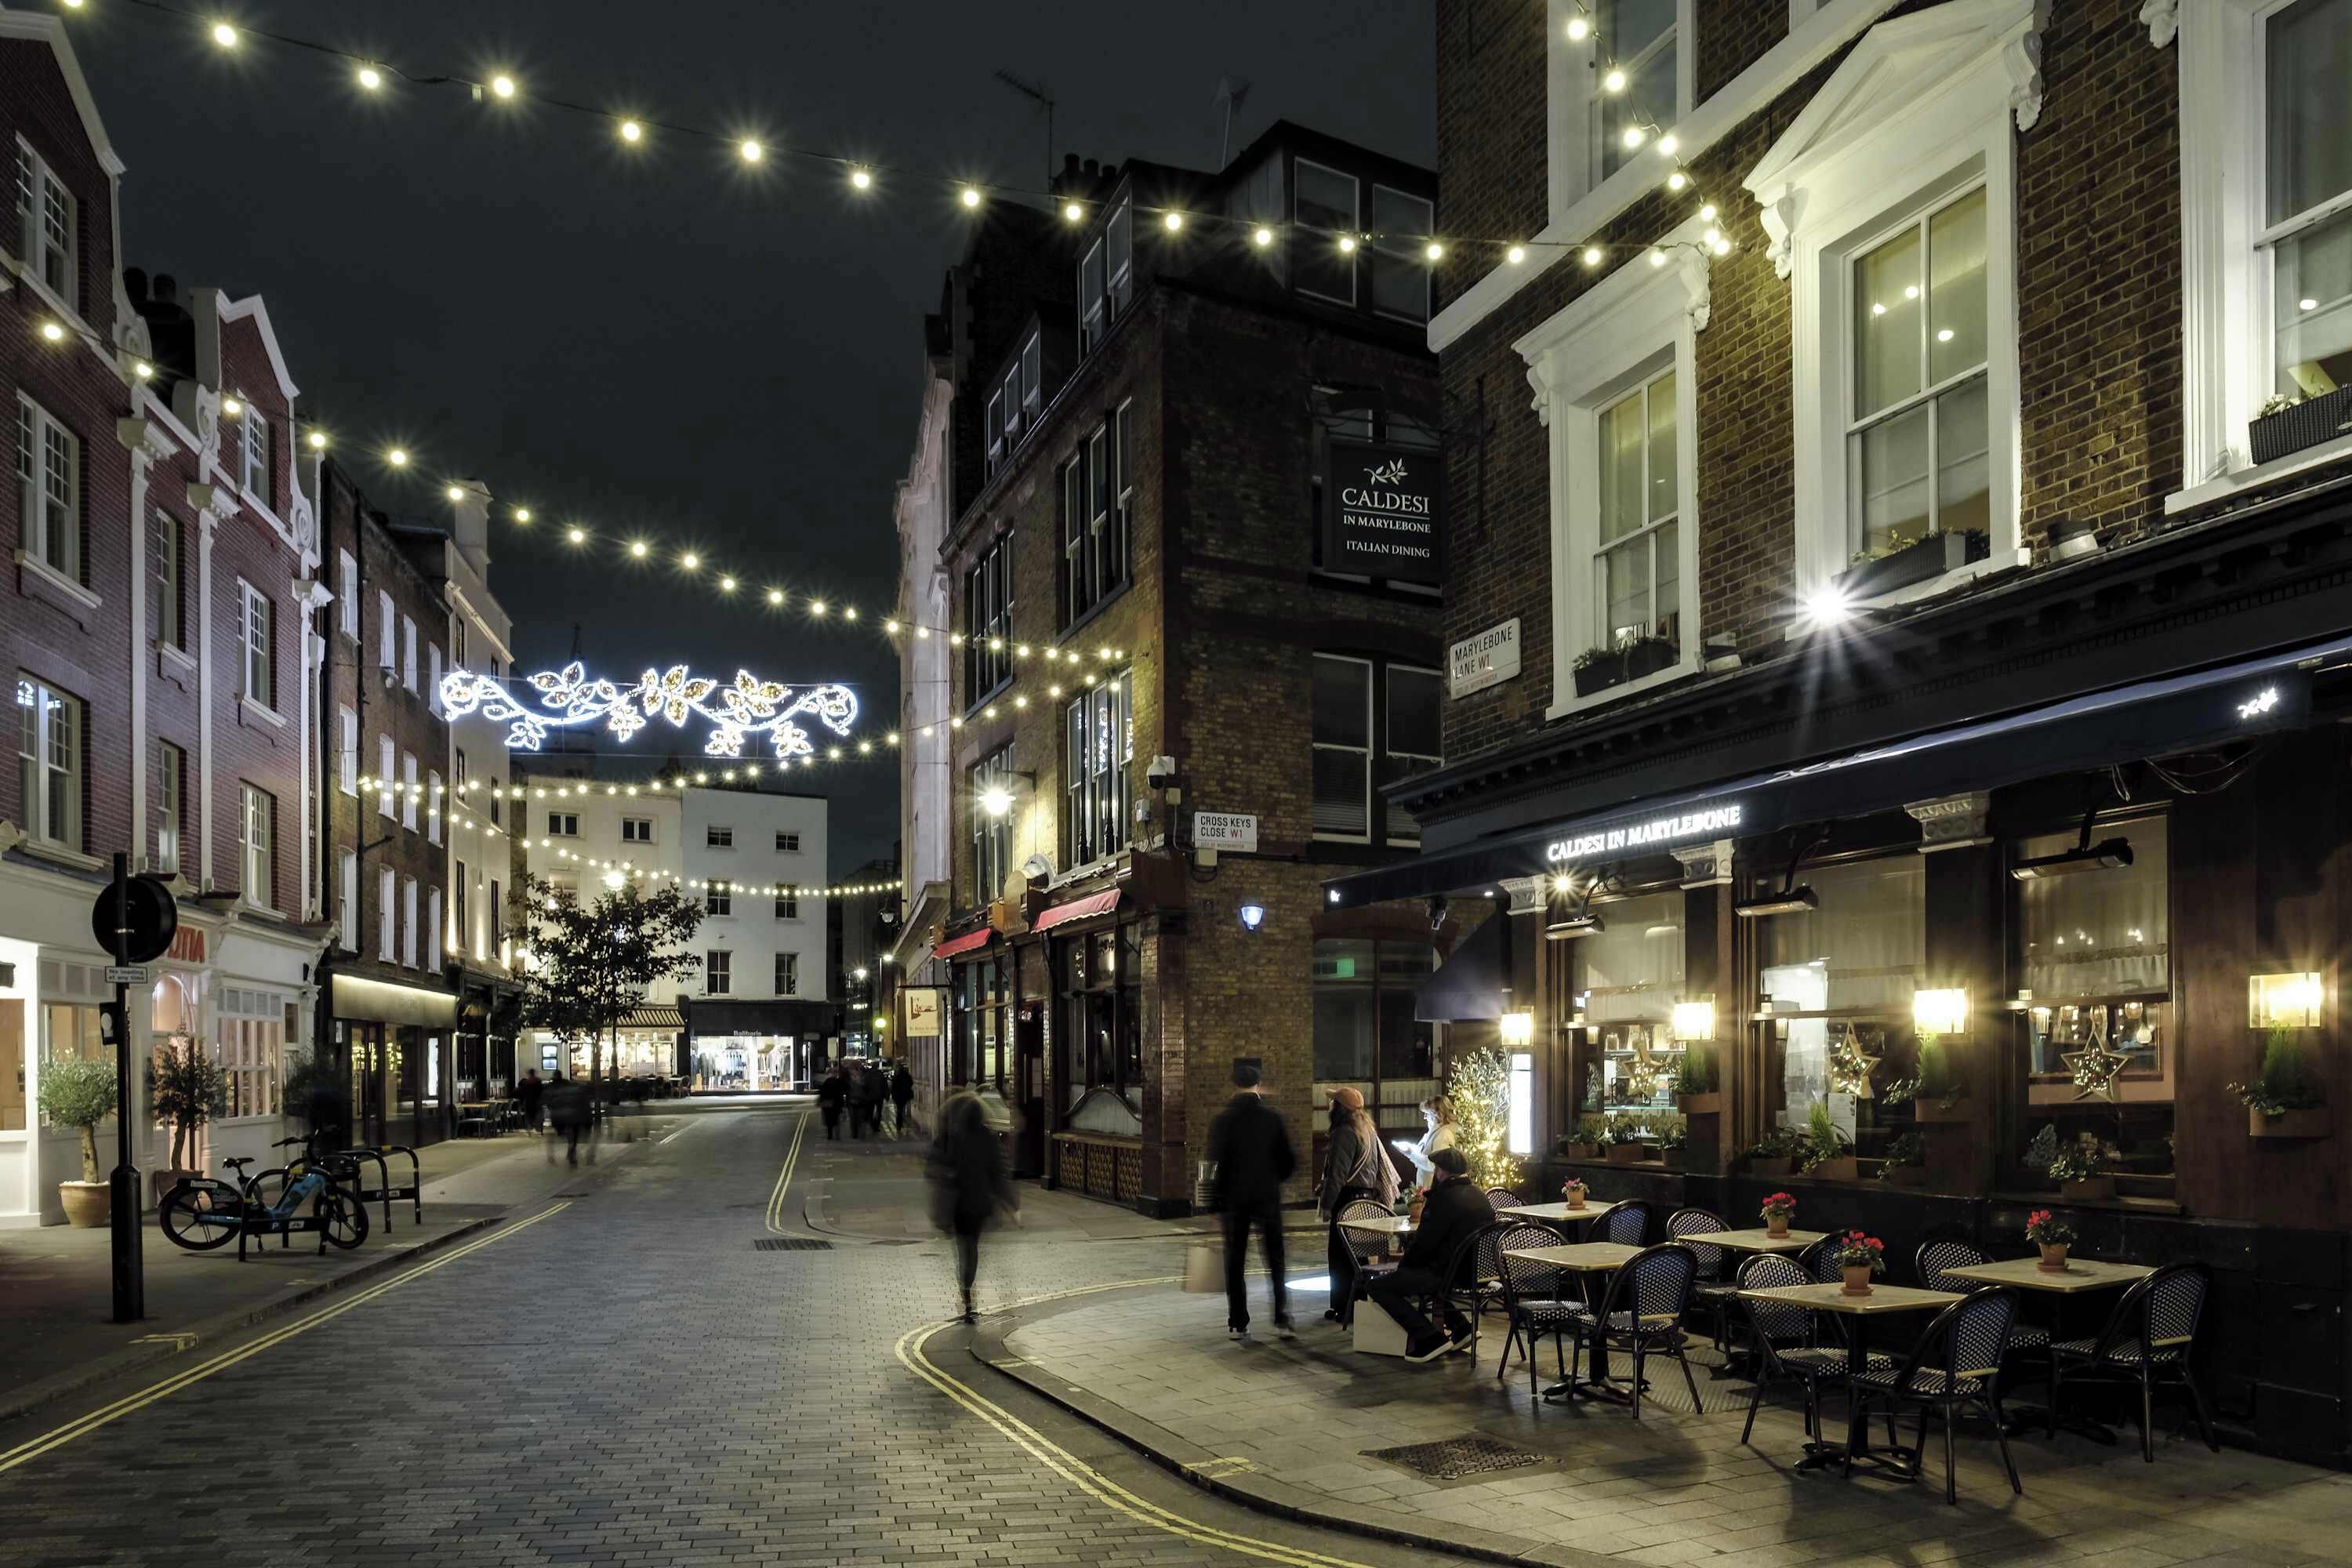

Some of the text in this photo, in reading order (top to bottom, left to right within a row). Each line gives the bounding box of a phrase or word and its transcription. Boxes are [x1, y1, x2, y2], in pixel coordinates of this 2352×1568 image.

[1341, 488, 1430, 514] CALDESI
[1343, 514, 1431, 534] IN MARYLEBONE
[1346, 540, 1430, 557] ITALIAN DINING
[1455, 626, 1512, 663] MARYLEBONE
[1455, 654, 1490, 680] LANE W1
[1200, 815, 1251, 828] CROSS KEYS
[1200, 827, 1243, 839] CLOSE W1
[1548, 806, 1740, 861] CALDESI IN MARYLEBONE
